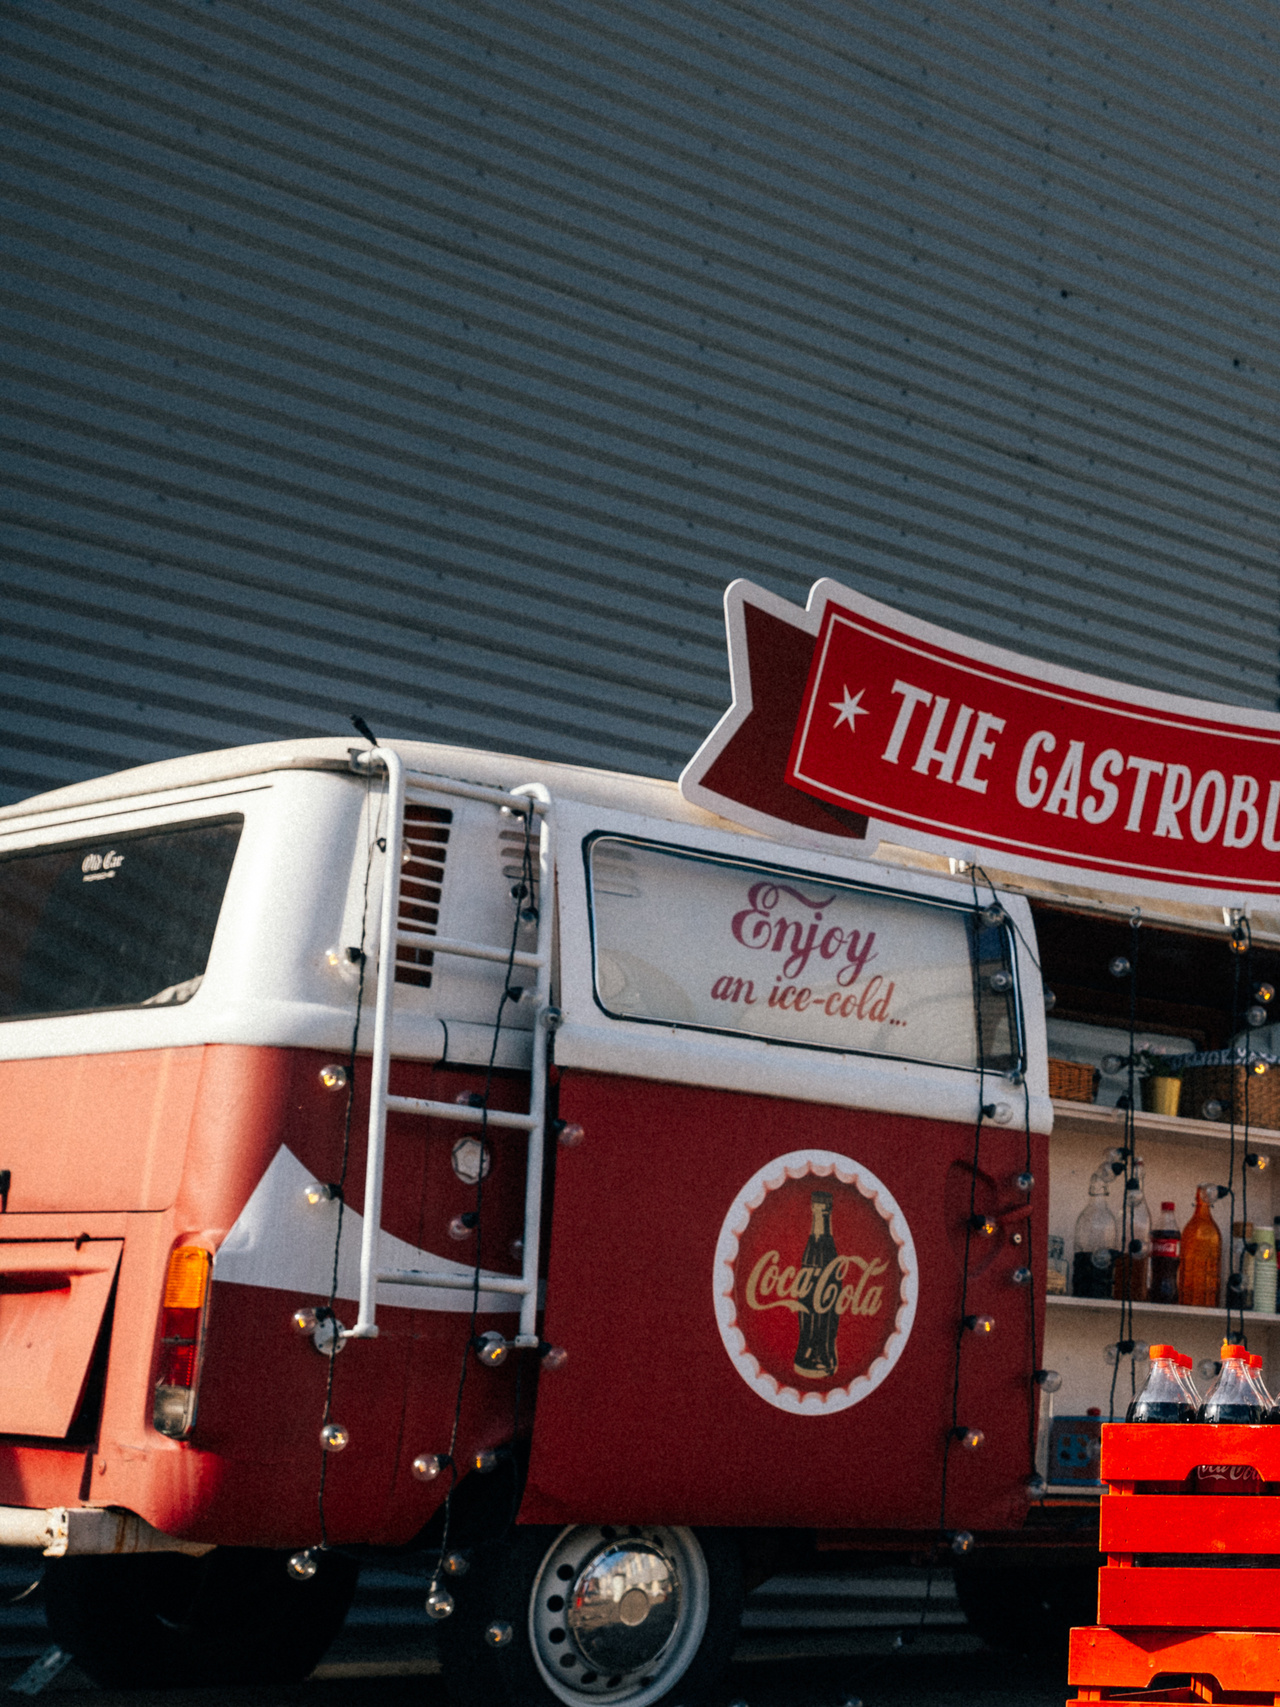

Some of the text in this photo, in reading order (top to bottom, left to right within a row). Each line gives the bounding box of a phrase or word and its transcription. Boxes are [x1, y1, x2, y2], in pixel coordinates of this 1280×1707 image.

[881, 679, 1007, 794] THE
[731, 881, 879, 987] Enjoy
[711, 975, 907, 1027] an ice-cold...
